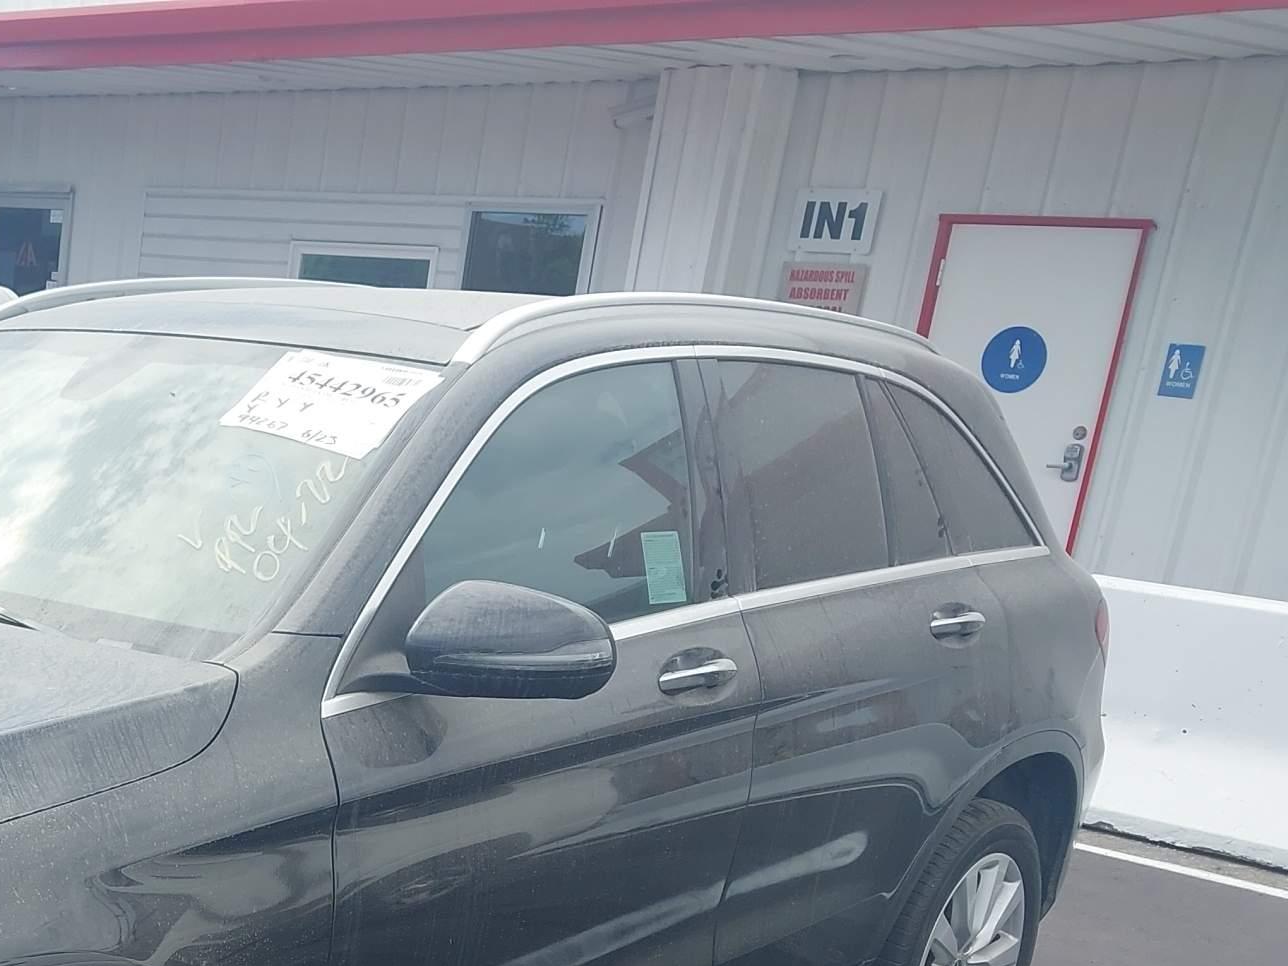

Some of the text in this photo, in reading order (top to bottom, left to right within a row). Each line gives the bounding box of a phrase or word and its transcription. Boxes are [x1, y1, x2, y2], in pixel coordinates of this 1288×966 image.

[799, 200, 869, 241] IN1
[789, 268, 856, 284] HAZARDOUS SPILL
[789, 286, 850, 301] ABSORBENT
[288, 370, 406, 409] 45442965
